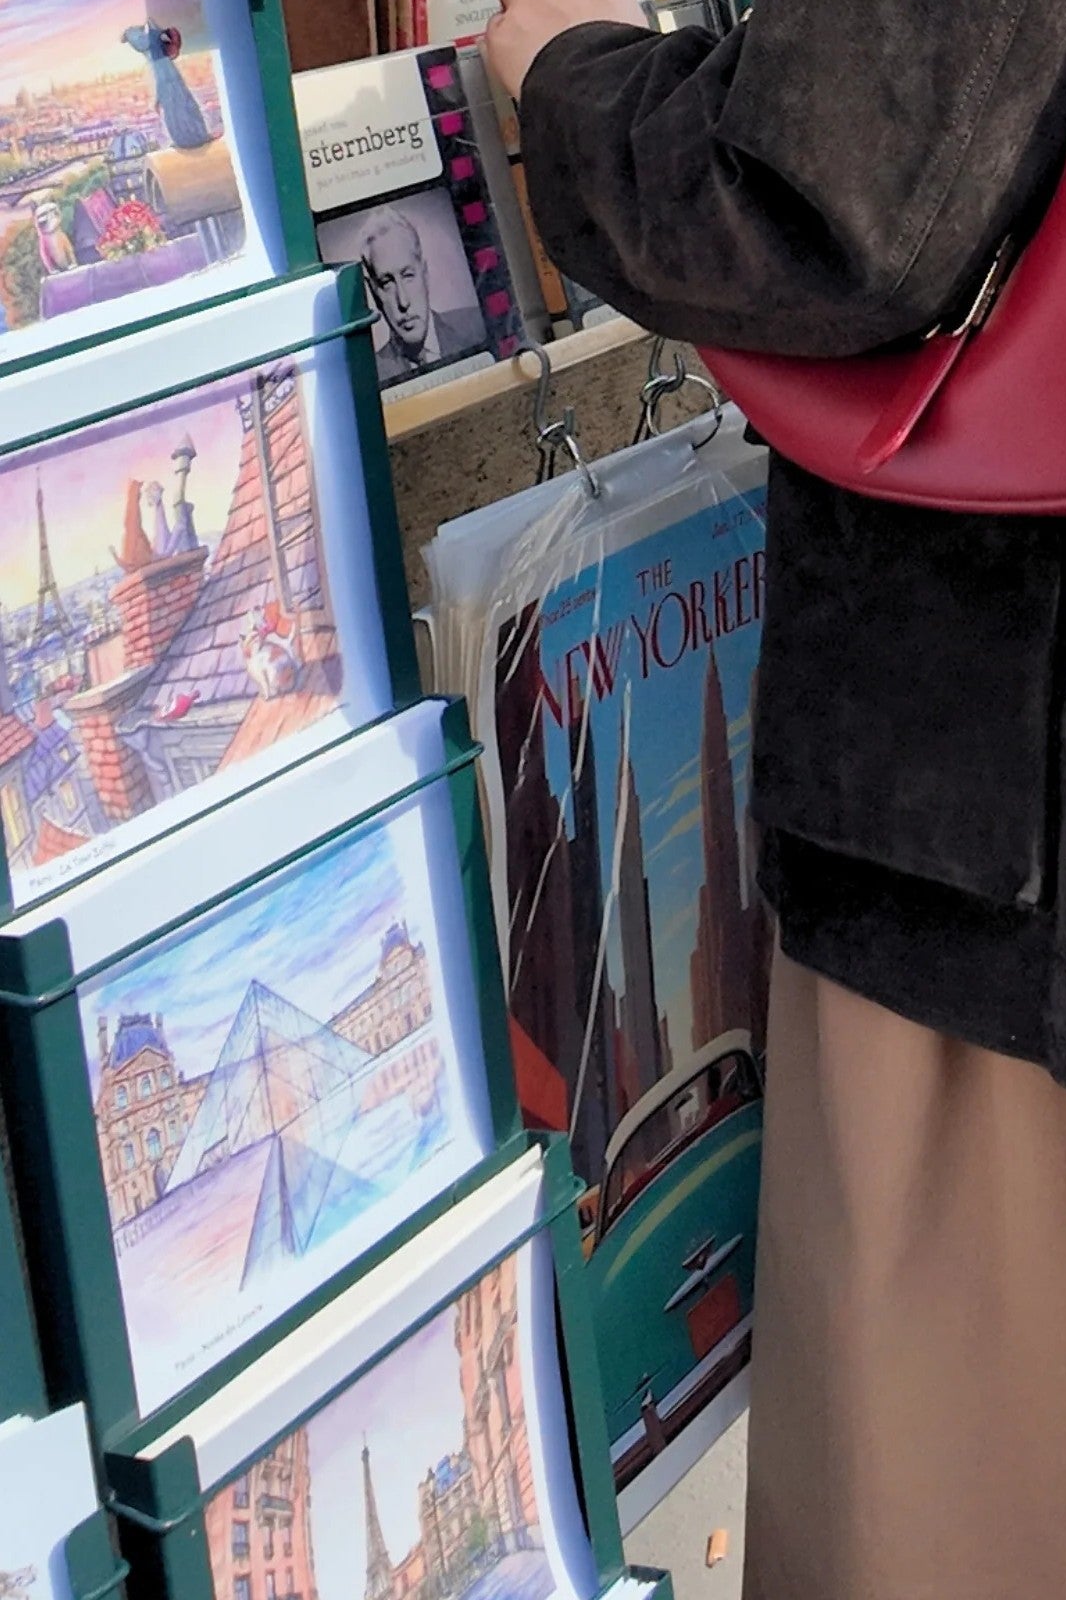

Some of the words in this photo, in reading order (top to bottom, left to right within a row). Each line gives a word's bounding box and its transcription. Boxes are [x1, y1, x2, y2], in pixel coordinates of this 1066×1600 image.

[309, 122, 424, 169] sternberg
[636, 558, 673, 598] THE
[539, 618, 627, 729] NEW
